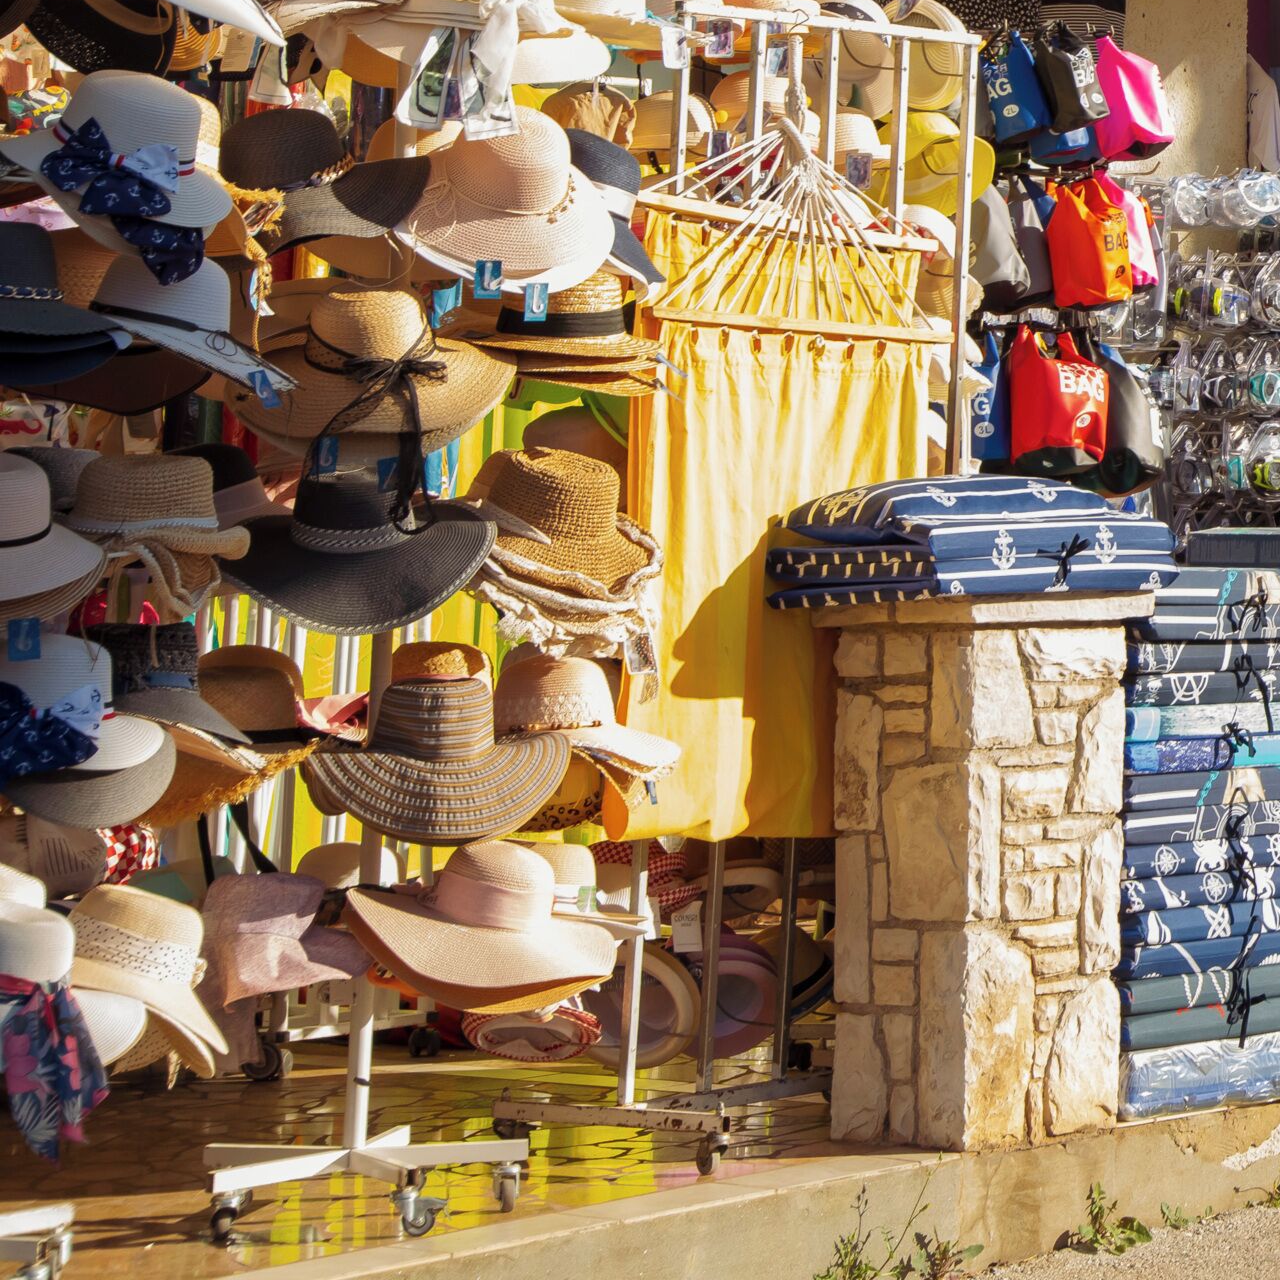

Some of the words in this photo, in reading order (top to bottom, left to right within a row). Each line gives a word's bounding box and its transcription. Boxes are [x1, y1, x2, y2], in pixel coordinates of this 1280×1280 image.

[986, 77, 1013, 102] AG
[1104, 231, 1129, 252] BAG
[1059, 371, 1105, 403] BAG
